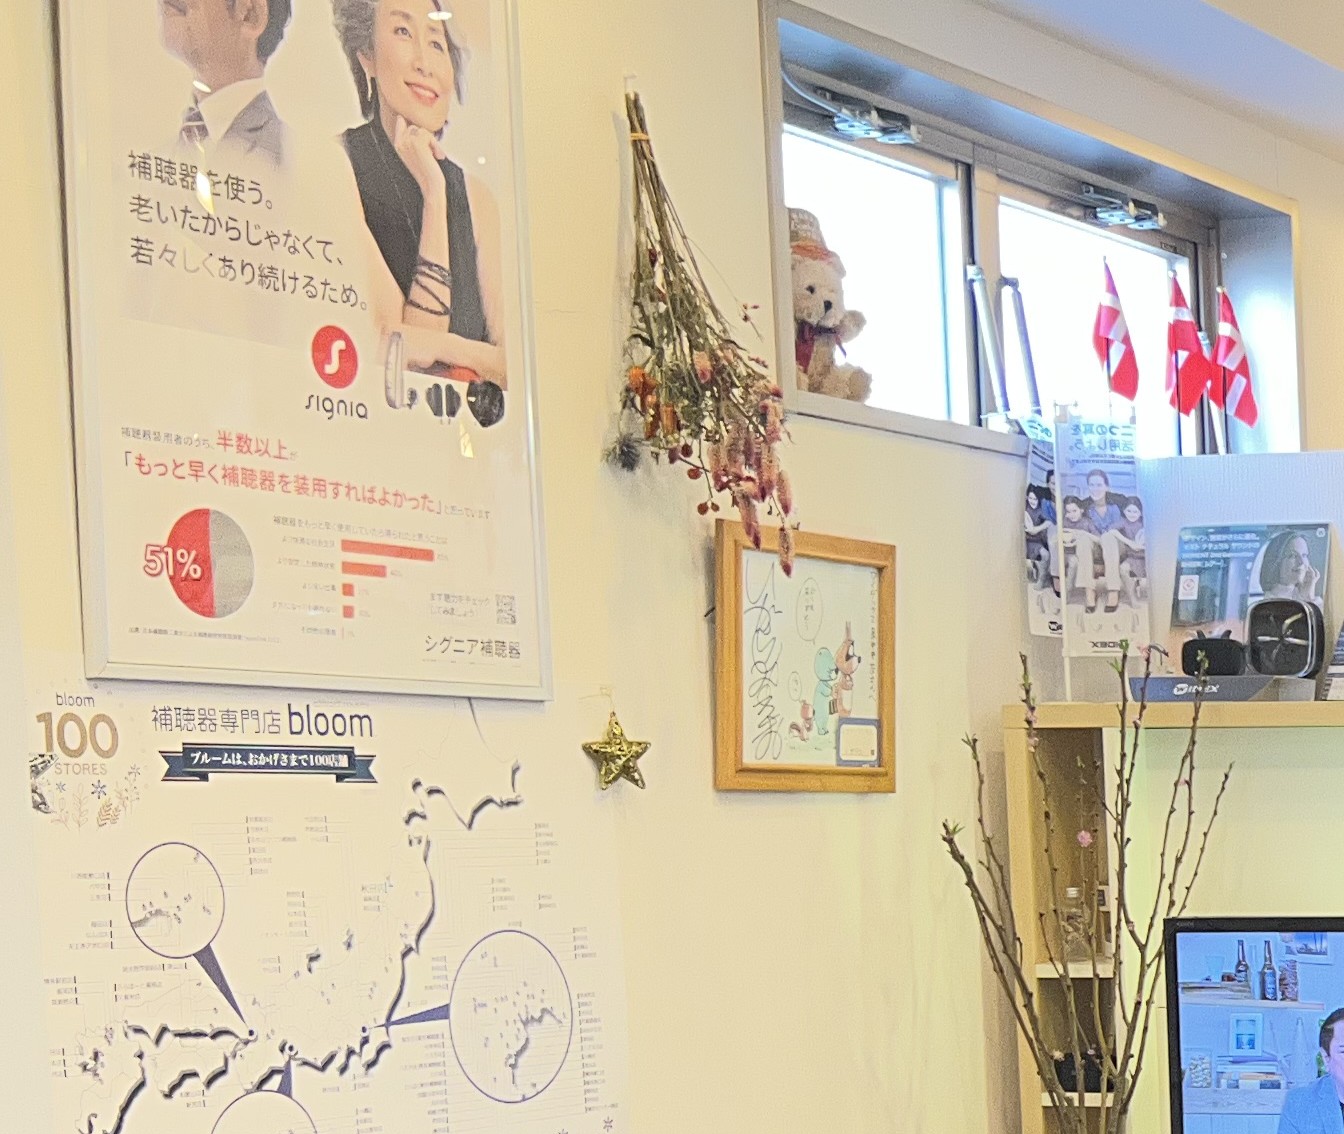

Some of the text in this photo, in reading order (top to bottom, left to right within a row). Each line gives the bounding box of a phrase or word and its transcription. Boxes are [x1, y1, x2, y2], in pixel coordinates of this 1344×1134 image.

[128, 153, 273, 210] 補聴器を使う。
[129, 194, 343, 266] 老いたからじゃなくて、
[130, 235, 367, 311] 若々しくあり続けるため。
[305, 395, 369, 420] signia
[143, 543, 203, 581] 51%
[425, 635, 521, 660] シグニア補聴器
[56, 692, 96, 708] bloom
[36, 711, 119, 759] 100
[151, 703, 375, 737] 補聴器専門店 bloom
[54, 762, 108, 776] STORES
